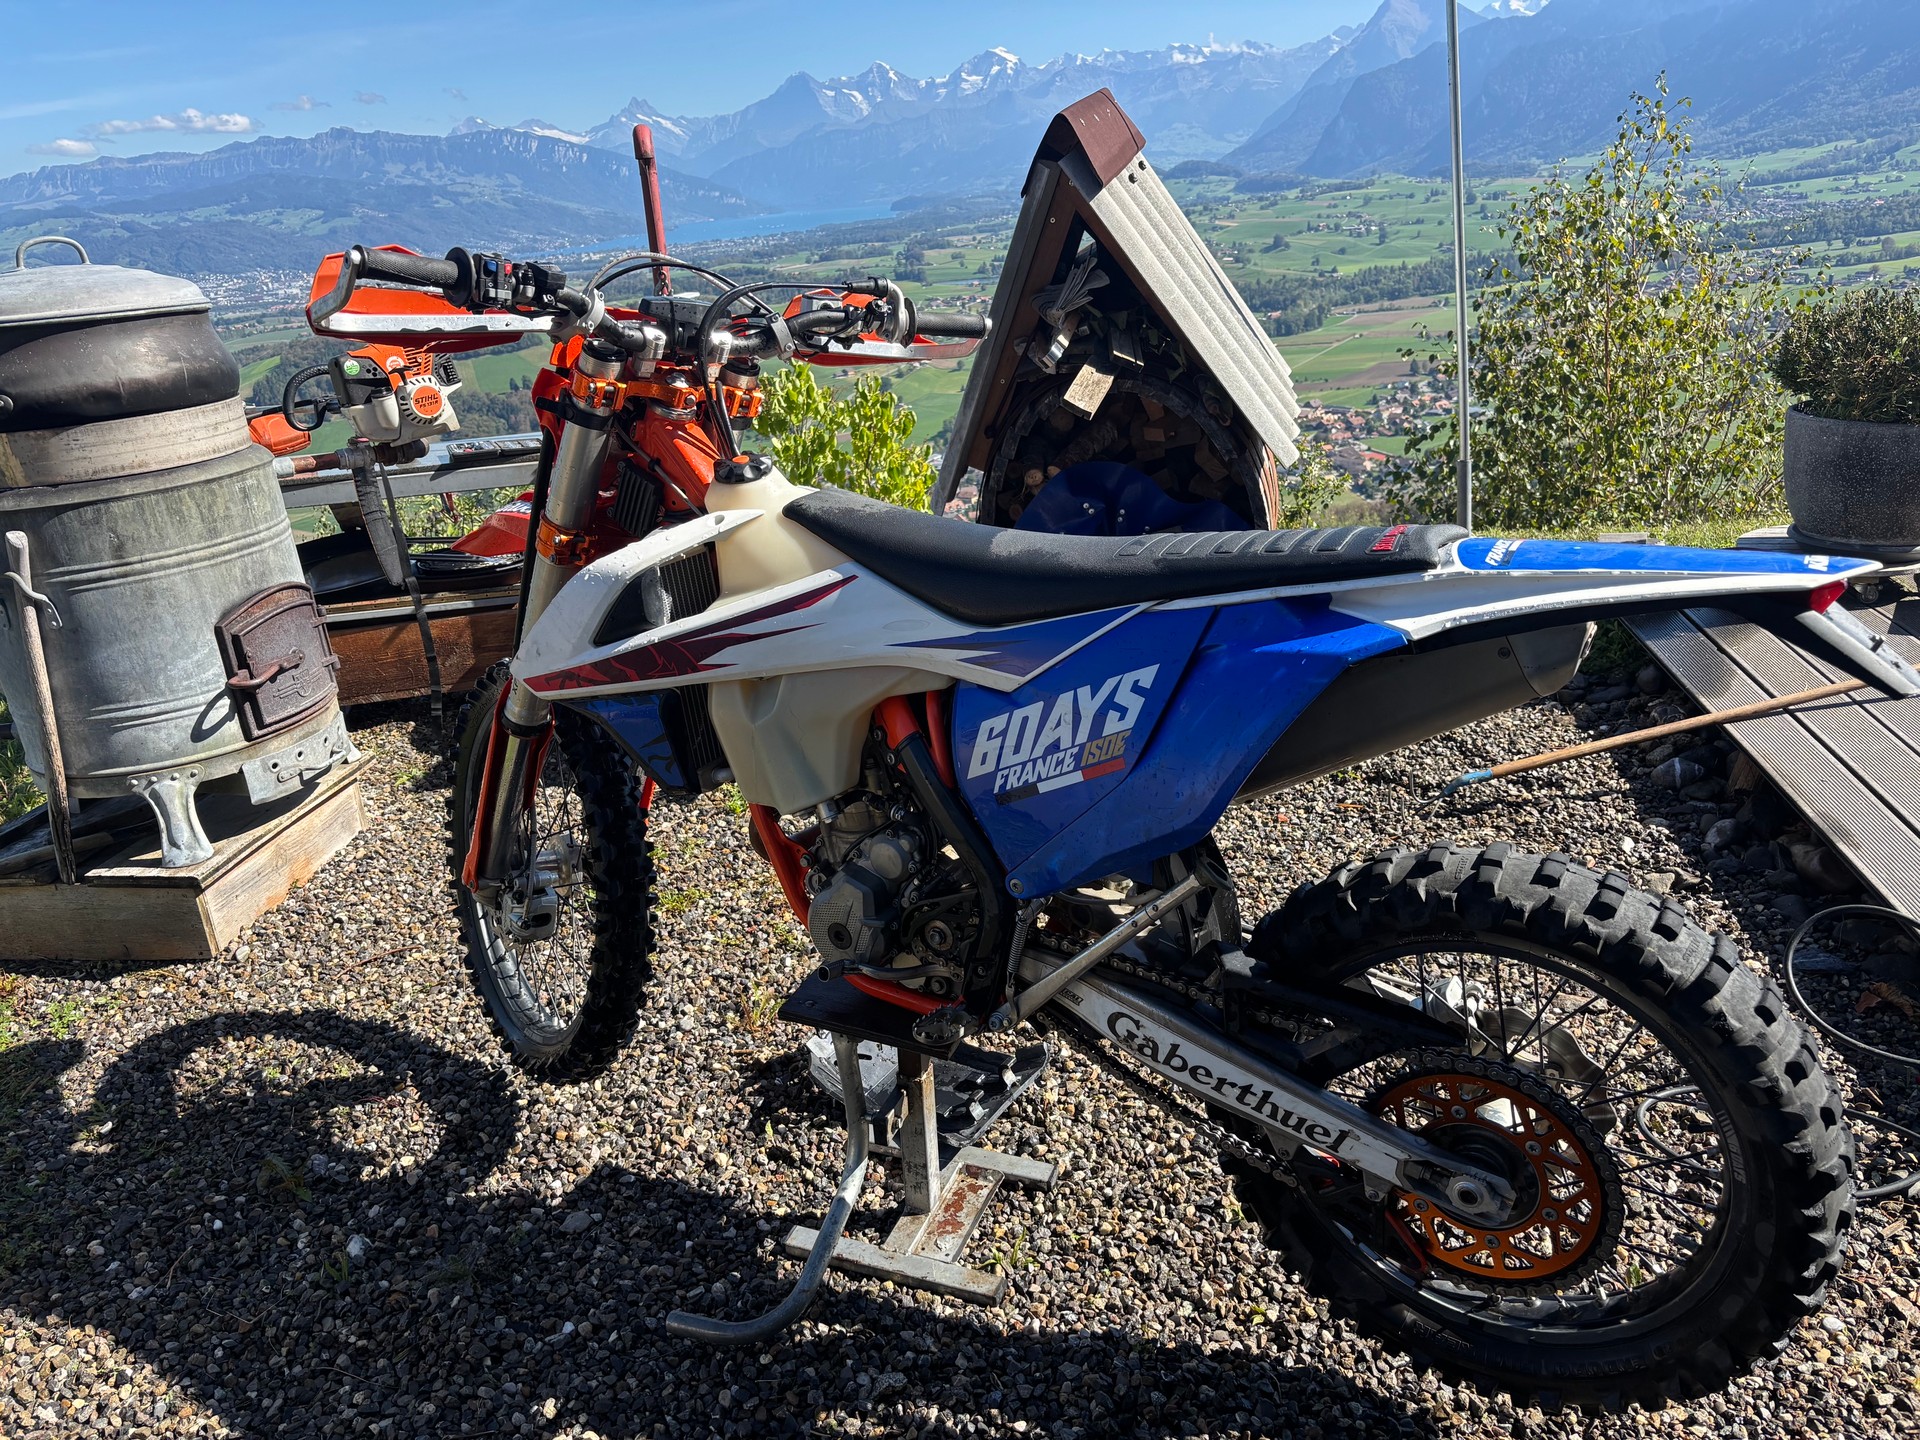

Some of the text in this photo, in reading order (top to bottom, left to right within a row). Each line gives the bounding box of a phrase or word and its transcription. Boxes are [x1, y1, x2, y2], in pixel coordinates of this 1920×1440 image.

[415, 393, 439, 405] STIHL
[967, 664, 1160, 780] 6DAYS
[993, 729, 1132, 794] FRANCE ISDE
[1107, 1011, 1352, 1154] Gaberthuel
